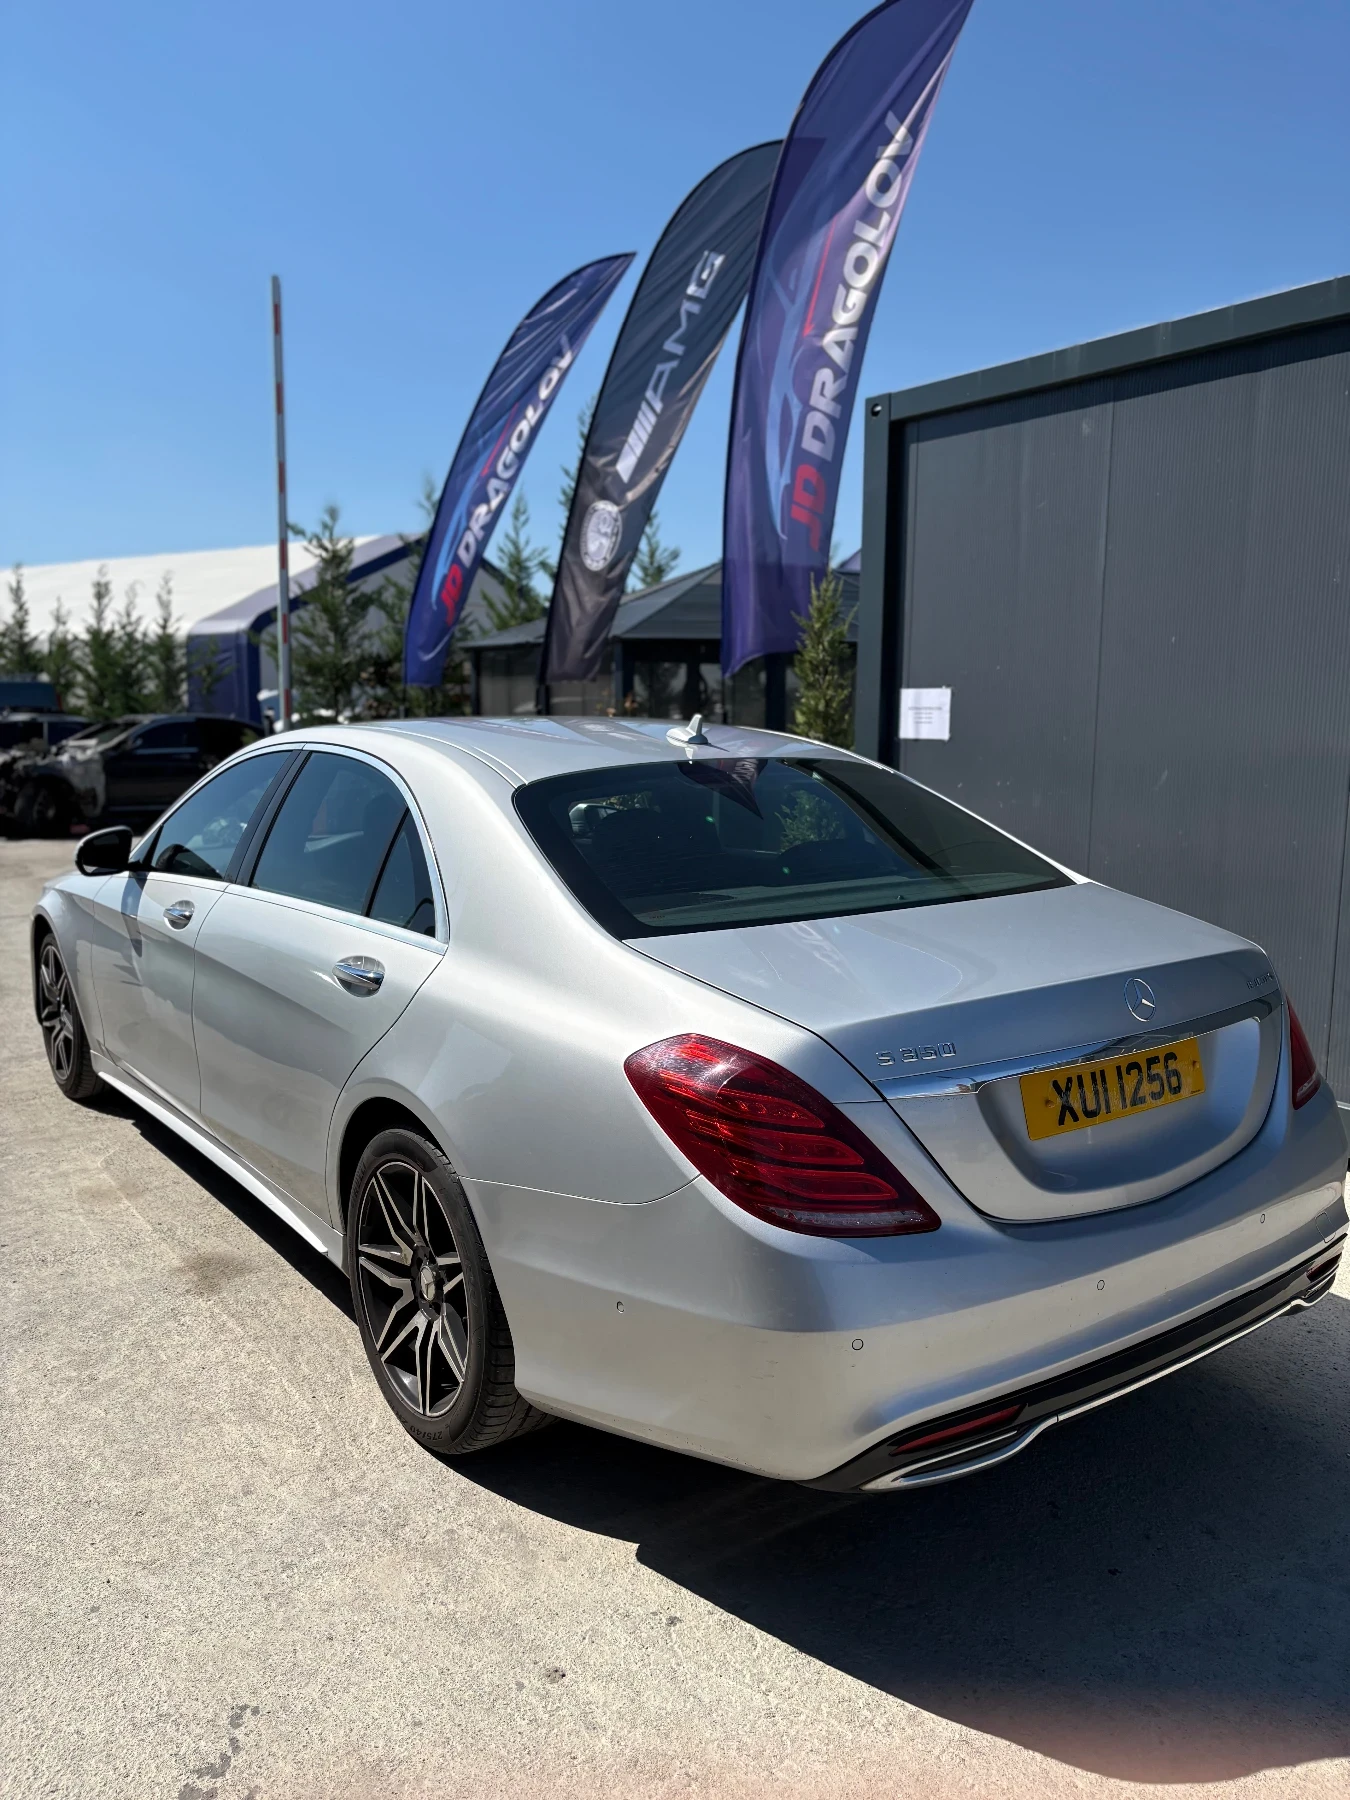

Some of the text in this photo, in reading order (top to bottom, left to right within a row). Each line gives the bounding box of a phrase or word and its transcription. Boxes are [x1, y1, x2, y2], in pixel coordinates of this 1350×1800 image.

[791, 110, 913, 552] JD DRAGOLOV
[441, 334, 573, 626] JD DRAGOLOV
[876, 1042, 956, 1066] S 350
